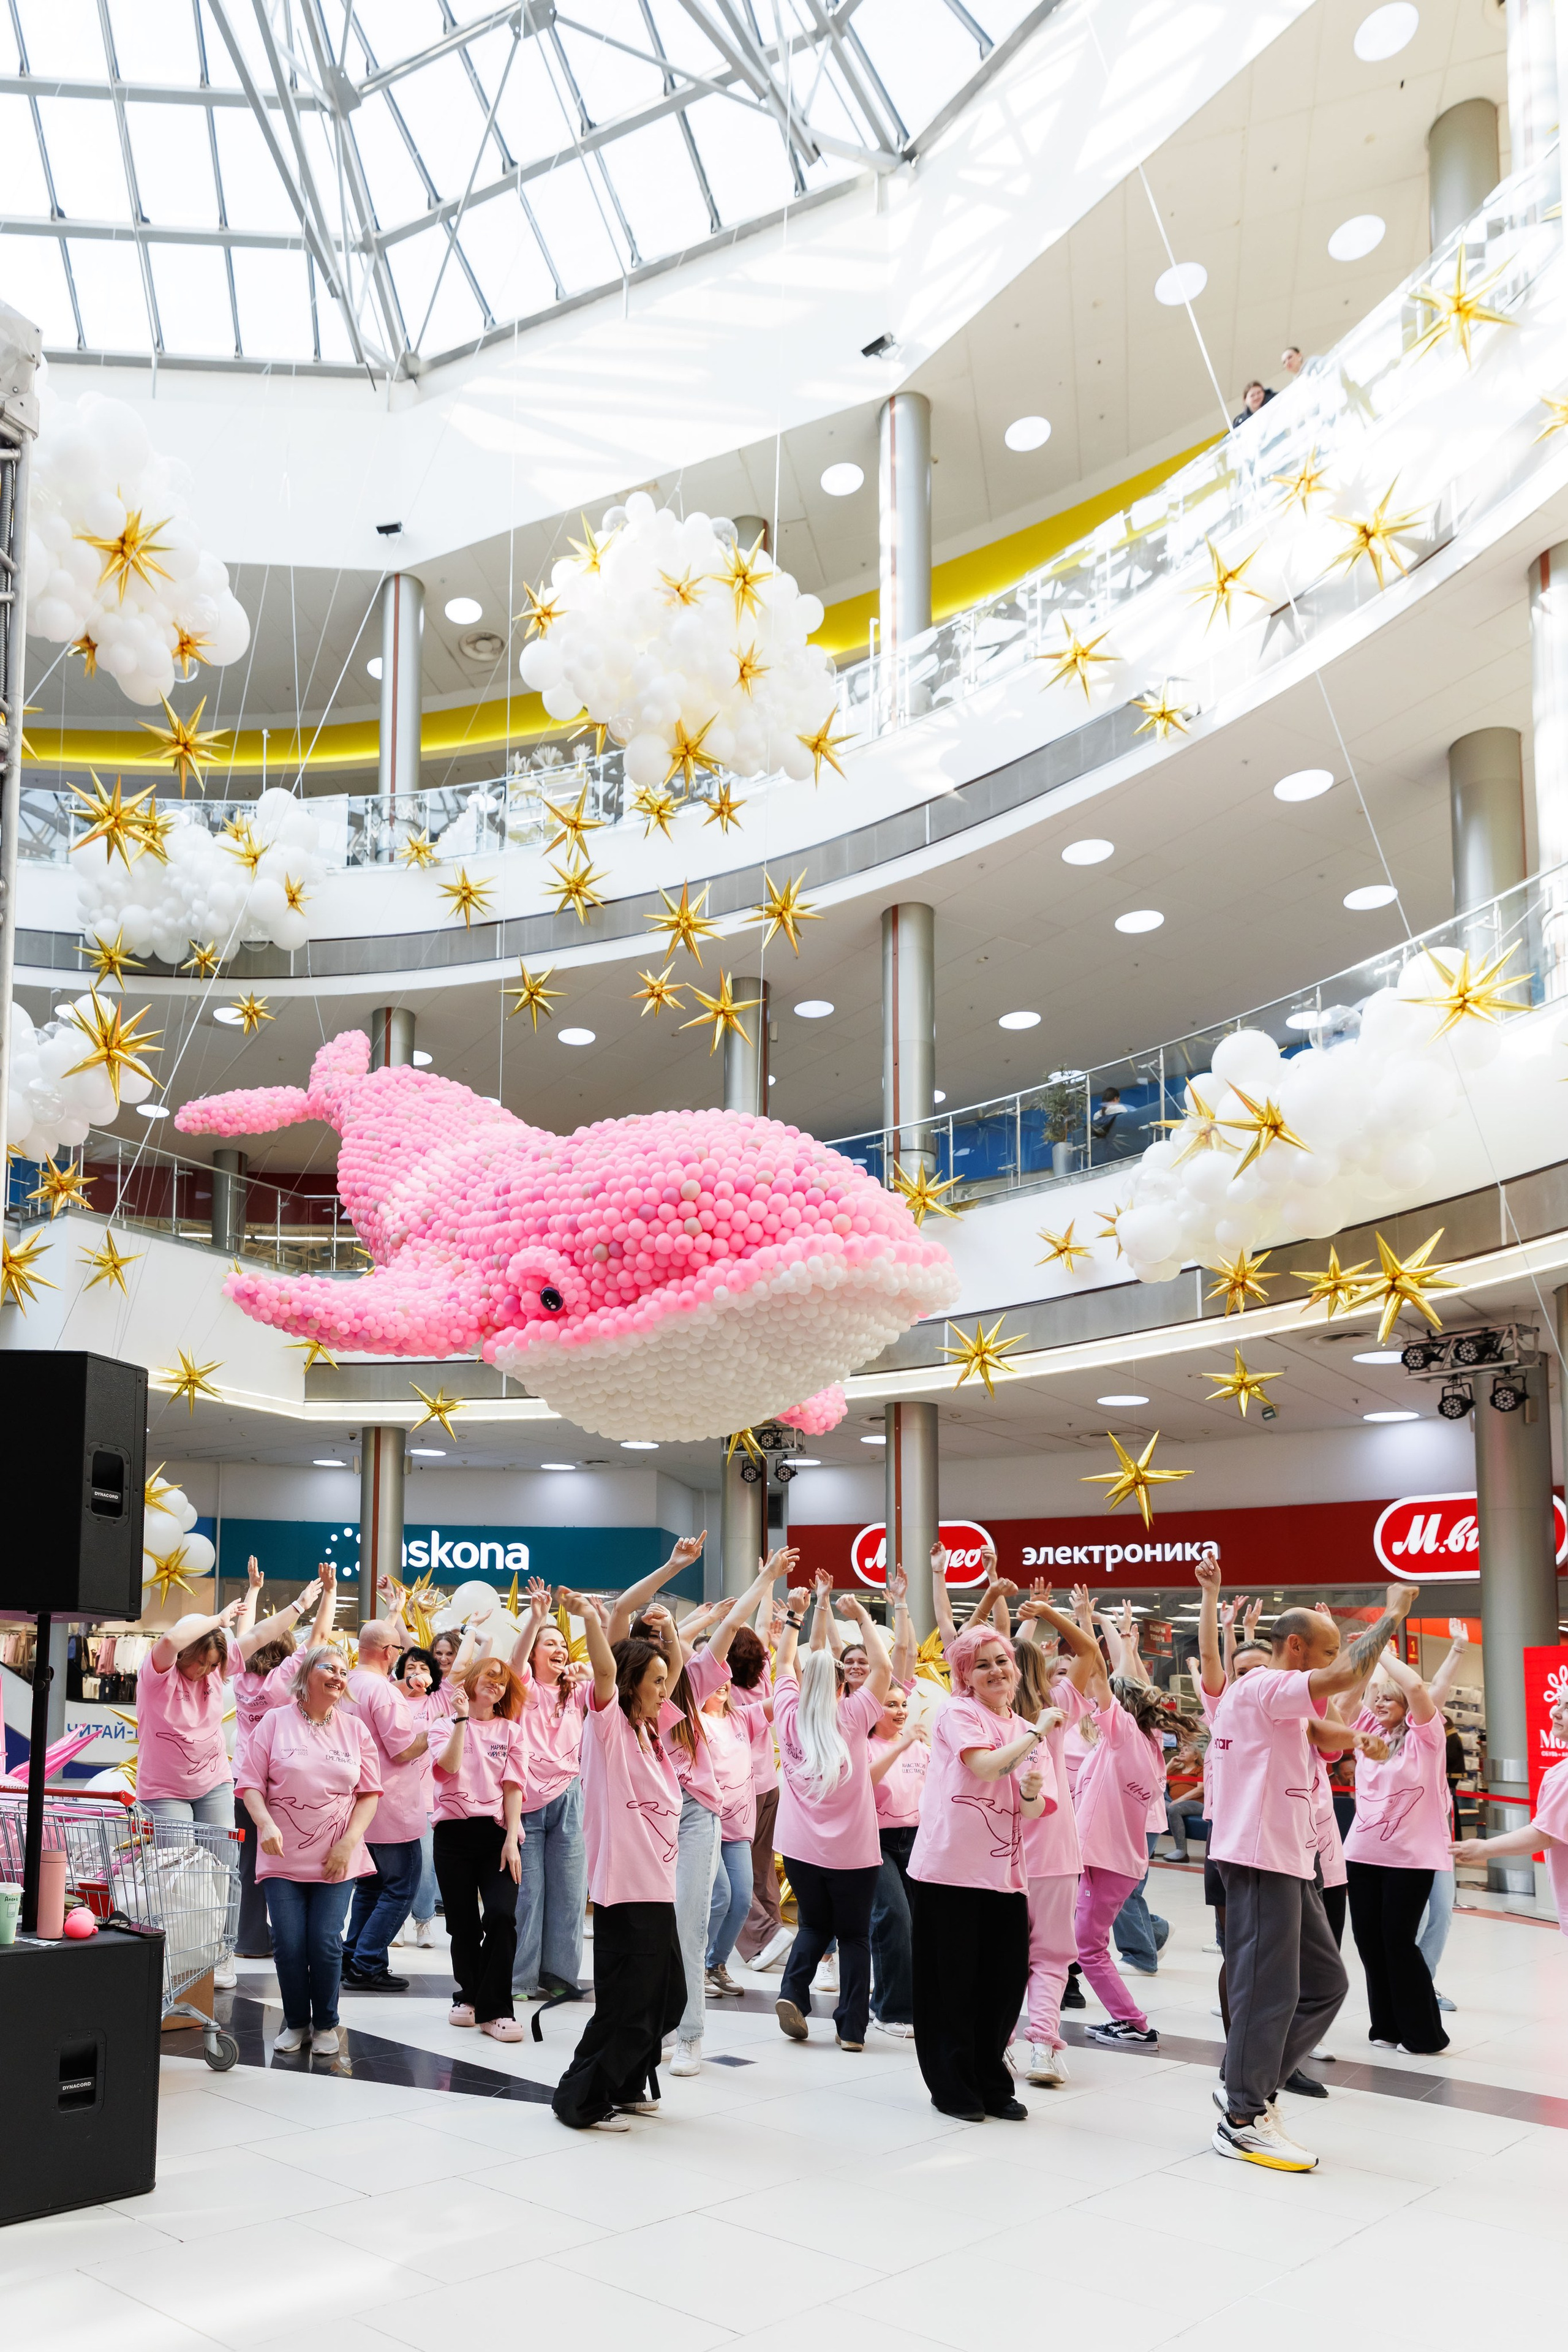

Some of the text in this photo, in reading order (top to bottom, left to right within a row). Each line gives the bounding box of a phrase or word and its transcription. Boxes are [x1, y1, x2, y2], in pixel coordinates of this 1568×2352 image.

[94, 1491, 119, 1499] DYNACORD
[402, 1530, 530, 1570] skona
[1022, 1540, 1219, 1572] электроника
[67, 1722, 138, 1739] ЧИТАЙ-
[62, 2081, 92, 2090] DYNACORD
